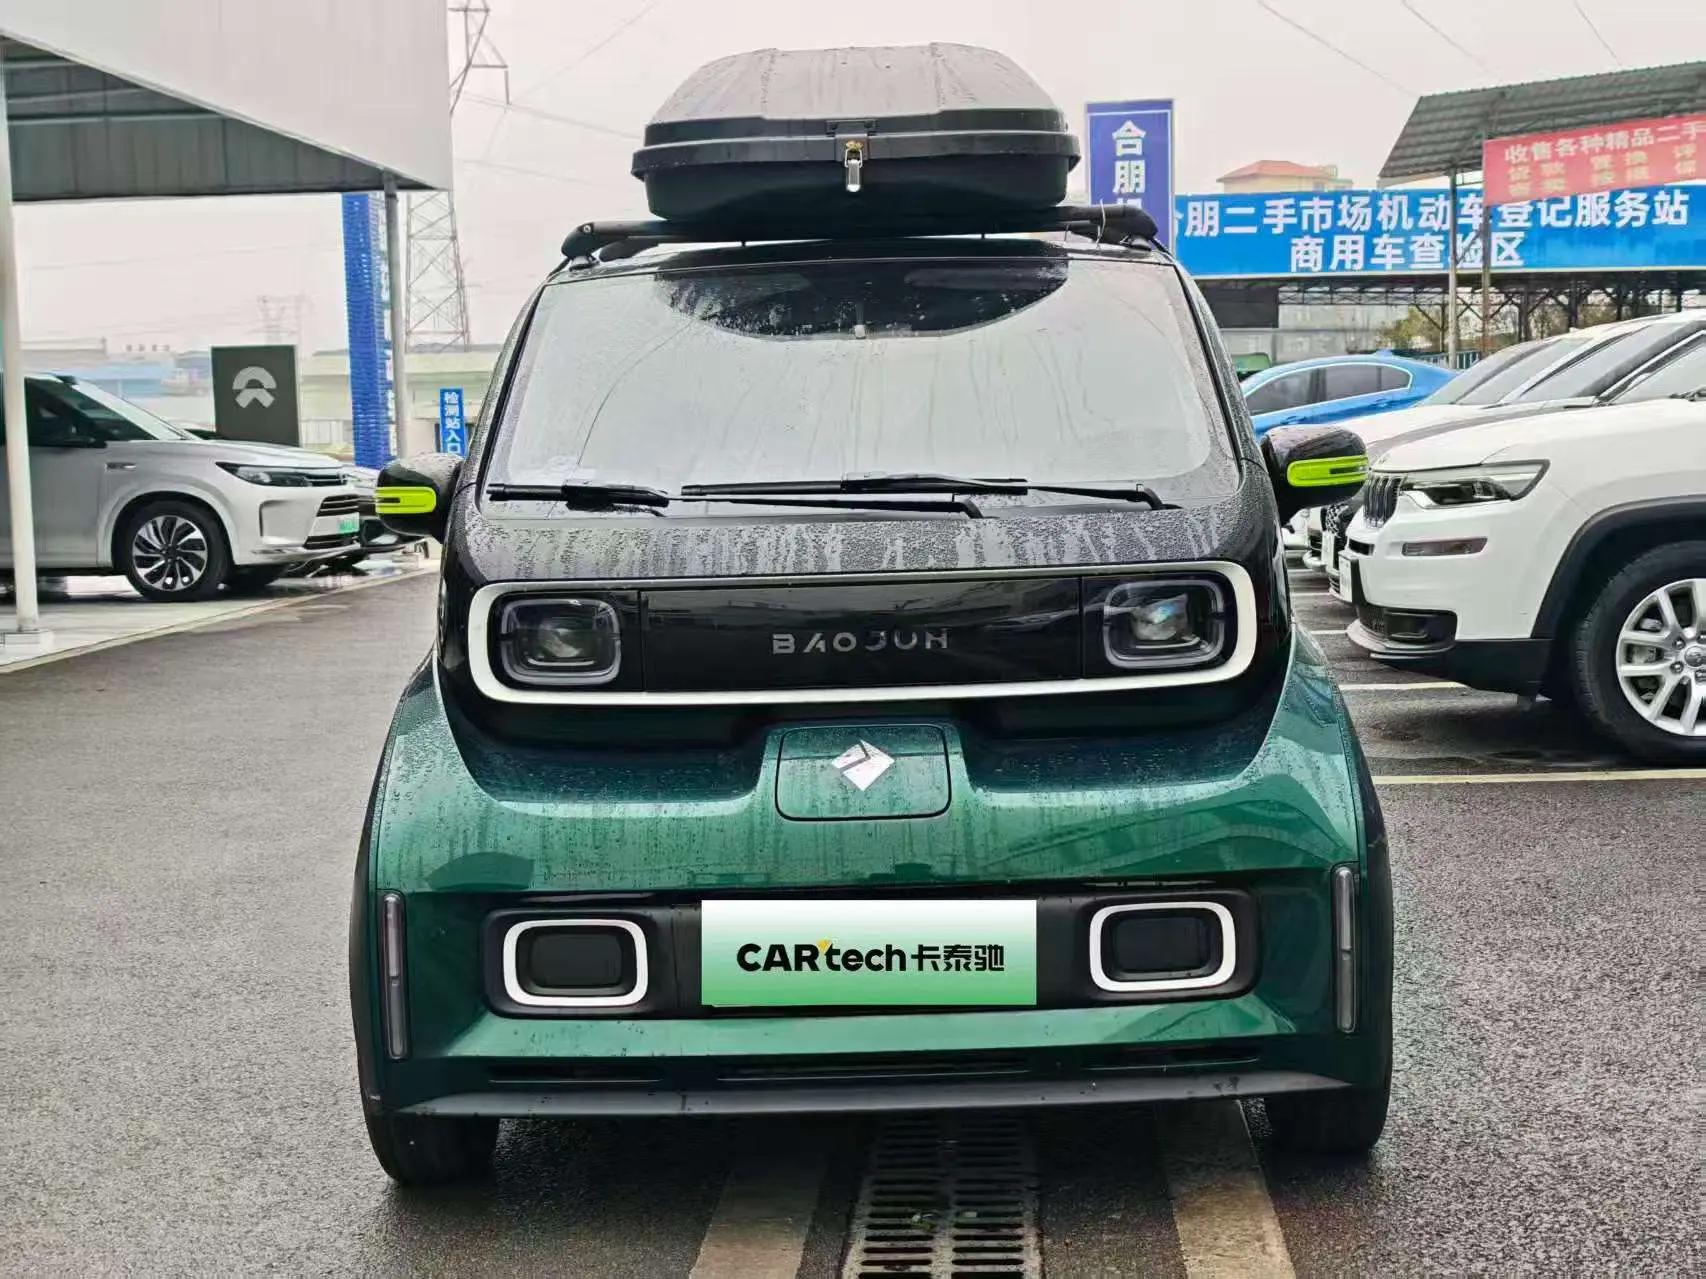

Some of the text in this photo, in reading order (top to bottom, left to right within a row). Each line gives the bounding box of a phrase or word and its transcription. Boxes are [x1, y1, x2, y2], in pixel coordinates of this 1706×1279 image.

[1111, 120, 1146, 209] 合朋
[1175, 189, 1690, 237] 朋二手市场机动车登记服务站
[1290, 231, 1525, 273] 商用车查验区
[444, 391, 461, 453] 检测站入口
[772, 628, 950, 654] BAOJUN
